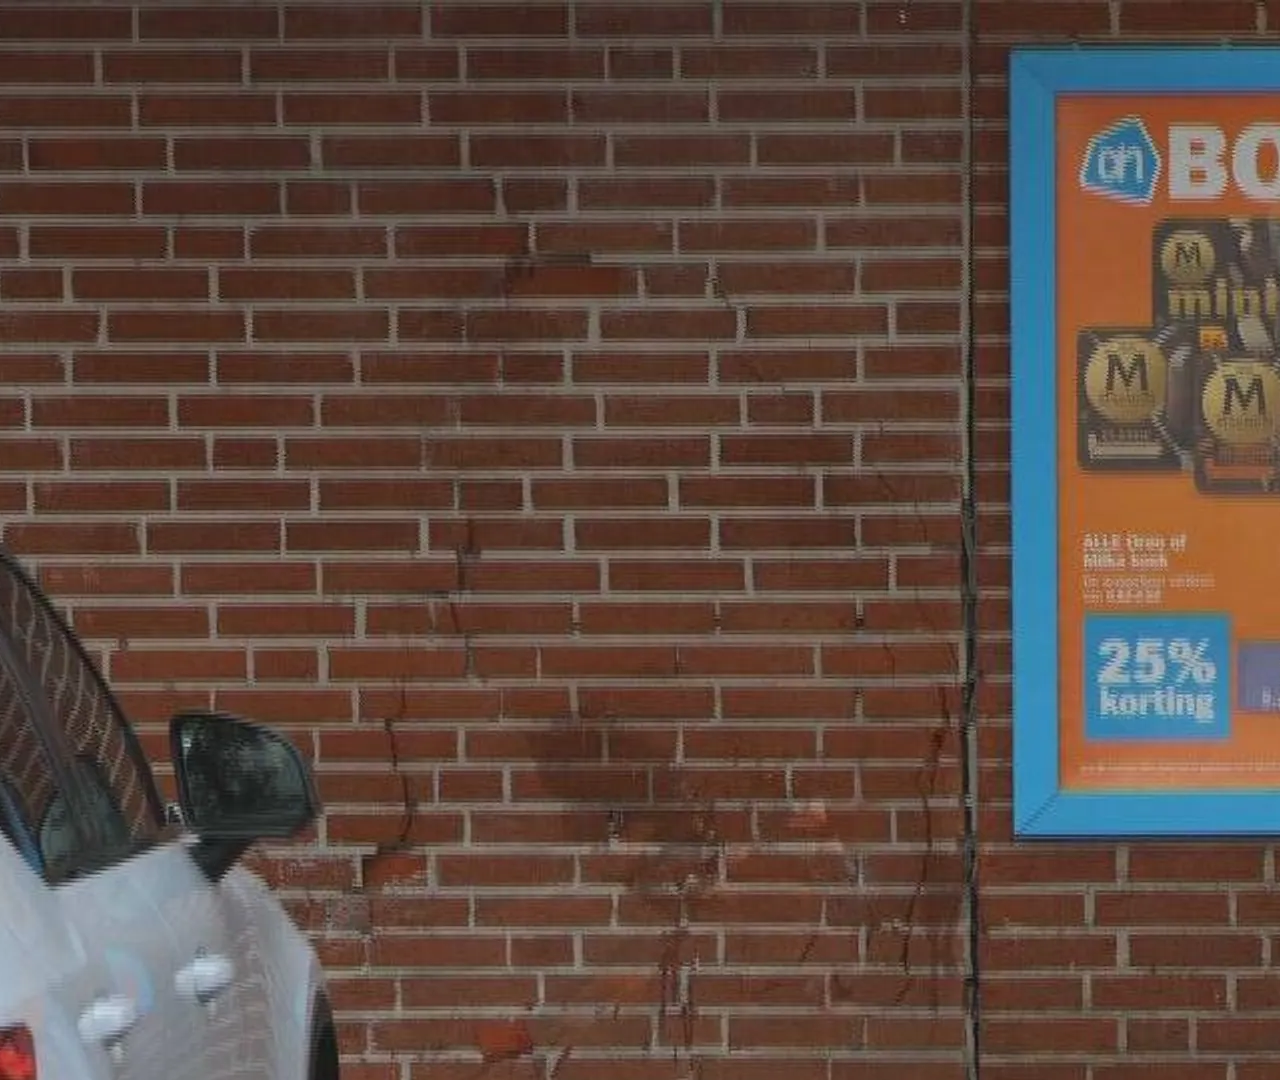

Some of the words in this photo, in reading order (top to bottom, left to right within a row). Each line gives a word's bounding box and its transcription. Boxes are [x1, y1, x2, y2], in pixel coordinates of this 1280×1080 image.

[1105, 352, 1150, 396] M
[1222, 376, 1267, 418] M
[1097, 637, 1217, 685] 25%
[1099, 686, 1216, 723] korting
